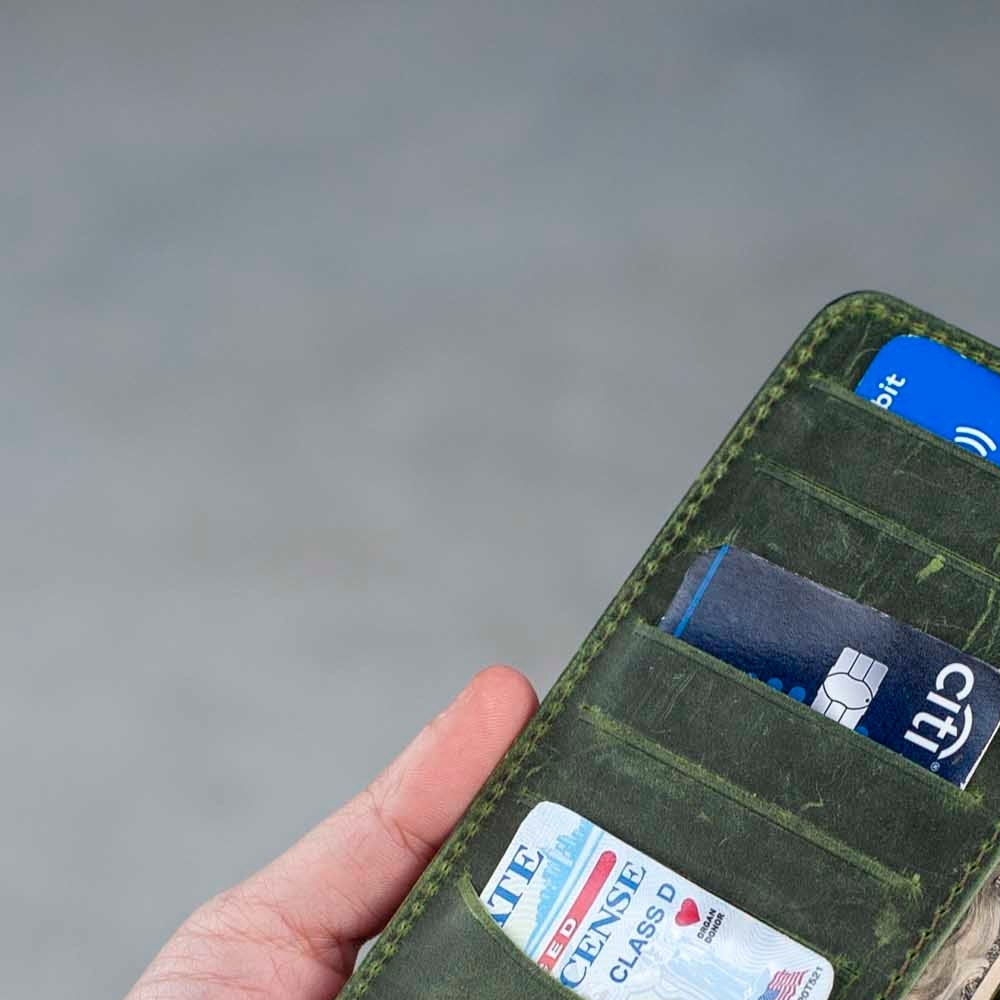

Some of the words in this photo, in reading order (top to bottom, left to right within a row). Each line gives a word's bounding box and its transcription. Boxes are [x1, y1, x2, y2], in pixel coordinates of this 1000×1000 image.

[870, 373, 906, 410] bit
[903, 662, 975, 760] citi
[539, 915, 578, 971] ED
[560, 860, 648, 989] CENSE
[609, 905, 665, 984] CLASS
[656, 882, 677, 904] D
[697, 907, 718, 940] ORGAN
[703, 912, 726, 945] DONOR
